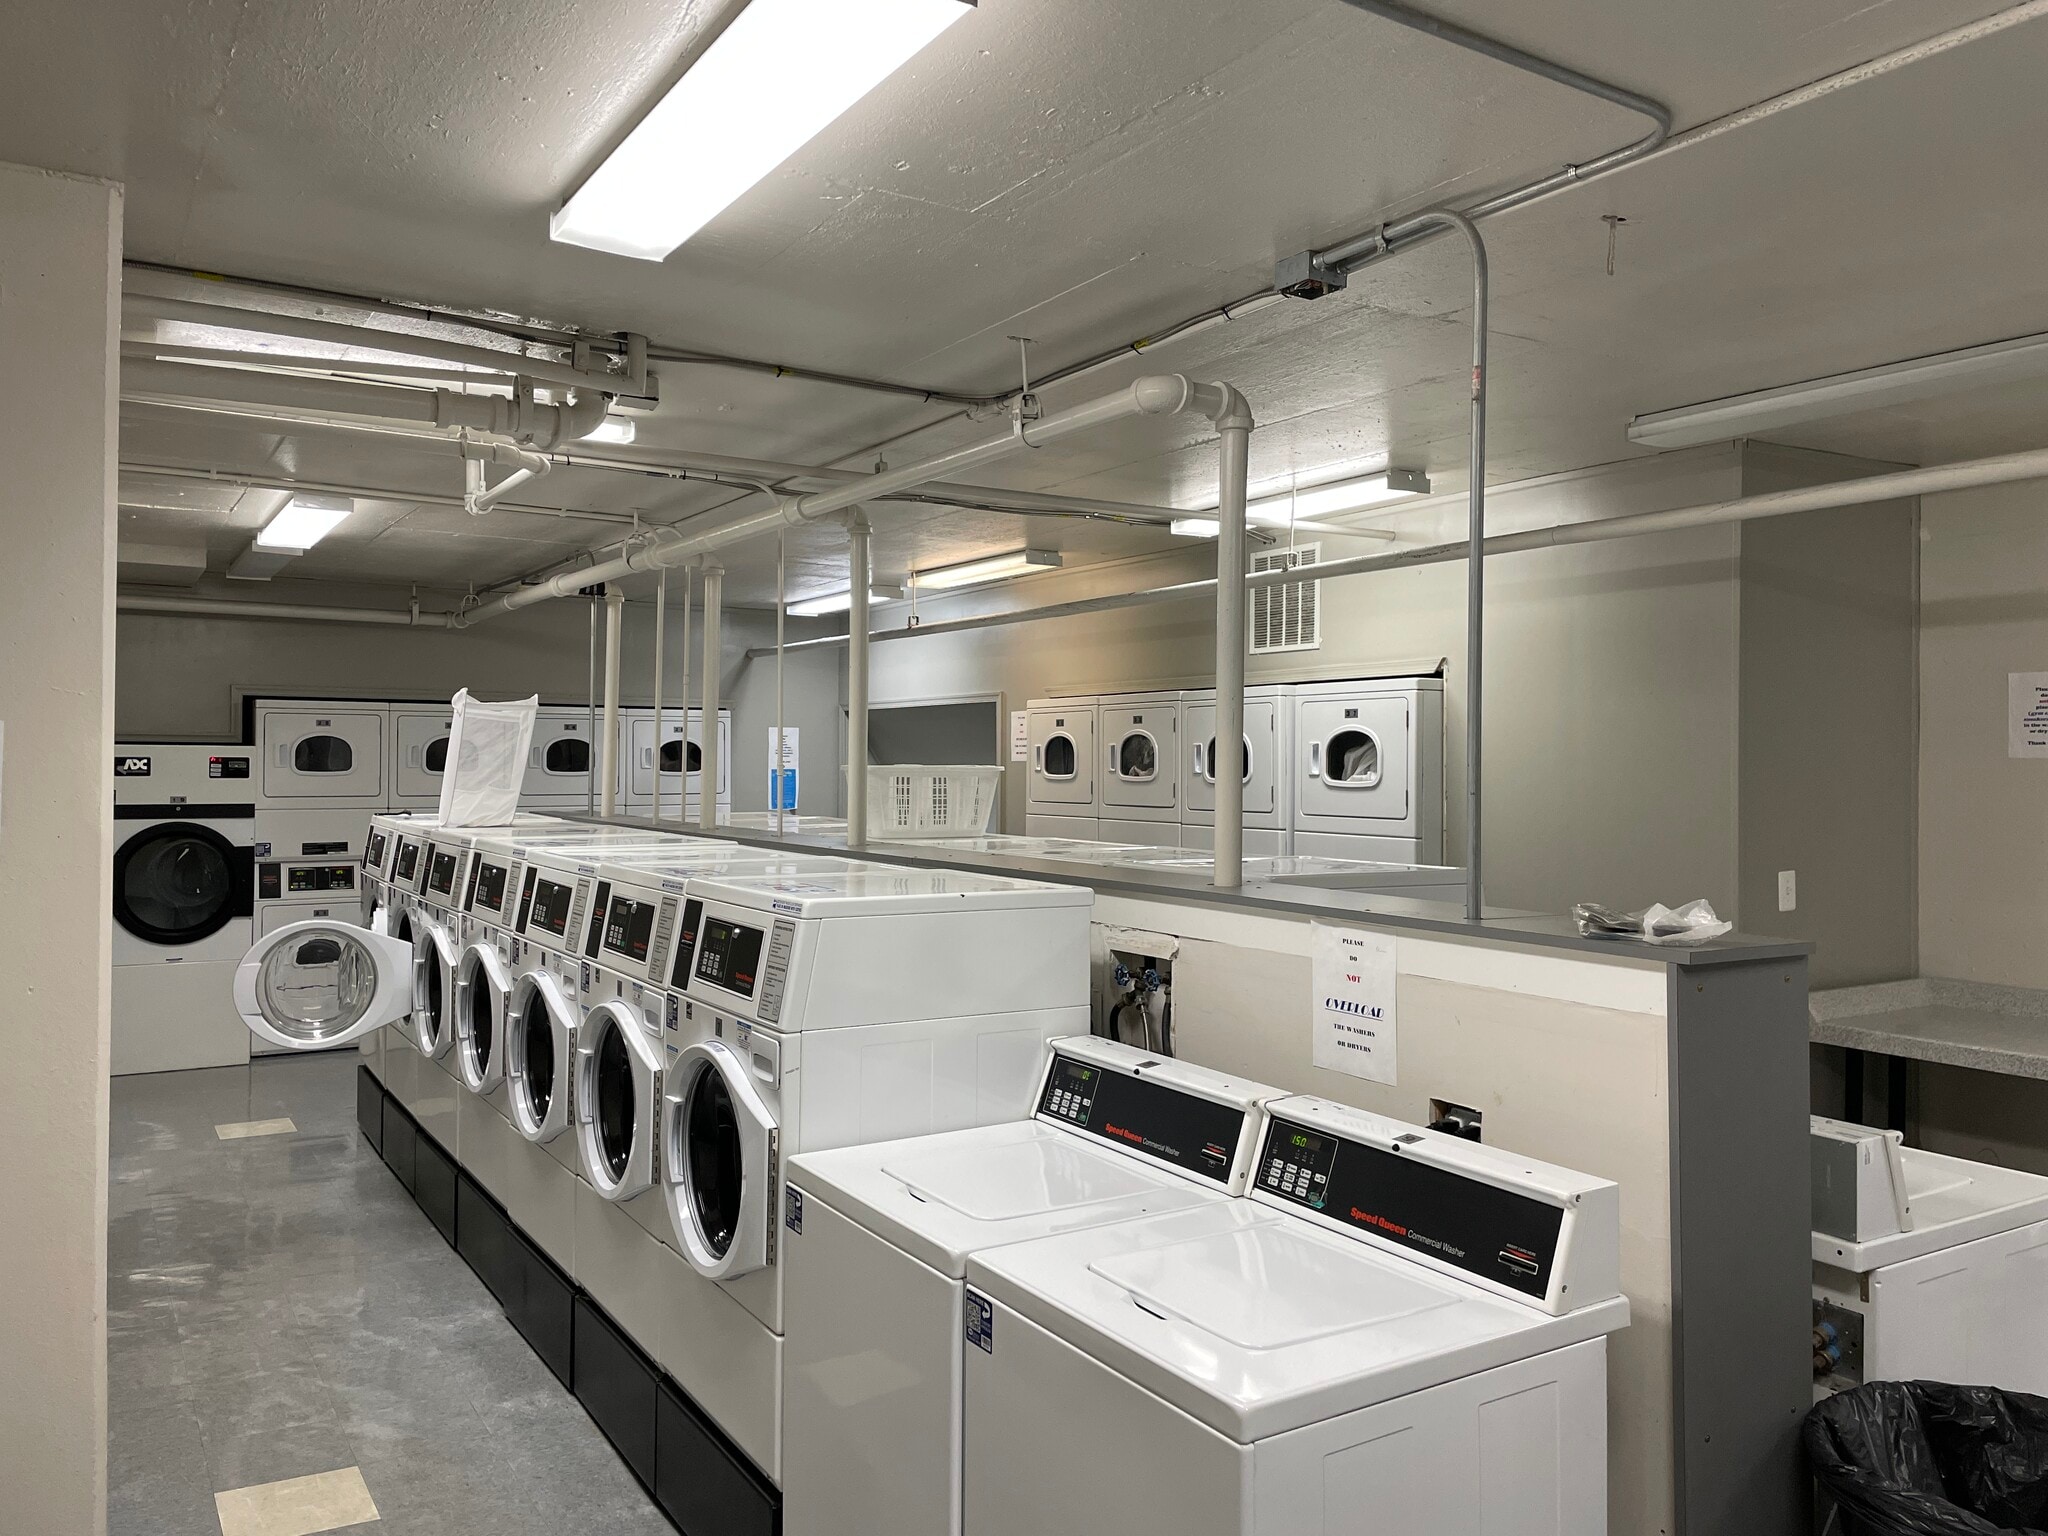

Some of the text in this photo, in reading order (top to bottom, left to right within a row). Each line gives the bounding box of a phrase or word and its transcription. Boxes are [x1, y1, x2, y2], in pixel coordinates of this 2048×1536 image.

[123, 758, 148, 770] ADC
[1342, 938, 1364, 947] PLEASE
[1346, 974, 1361, 984] NOT
[1325, 997, 1385, 1018] OVERLOAD
[1334, 1023, 1376, 1038] THE WASHERS
[1347, 1042, 1372, 1053] DRYERS
[1105, 1123, 1124, 1136] Speed
[1350, 1207, 1466, 1258] Speed Queen Commercial Washer
